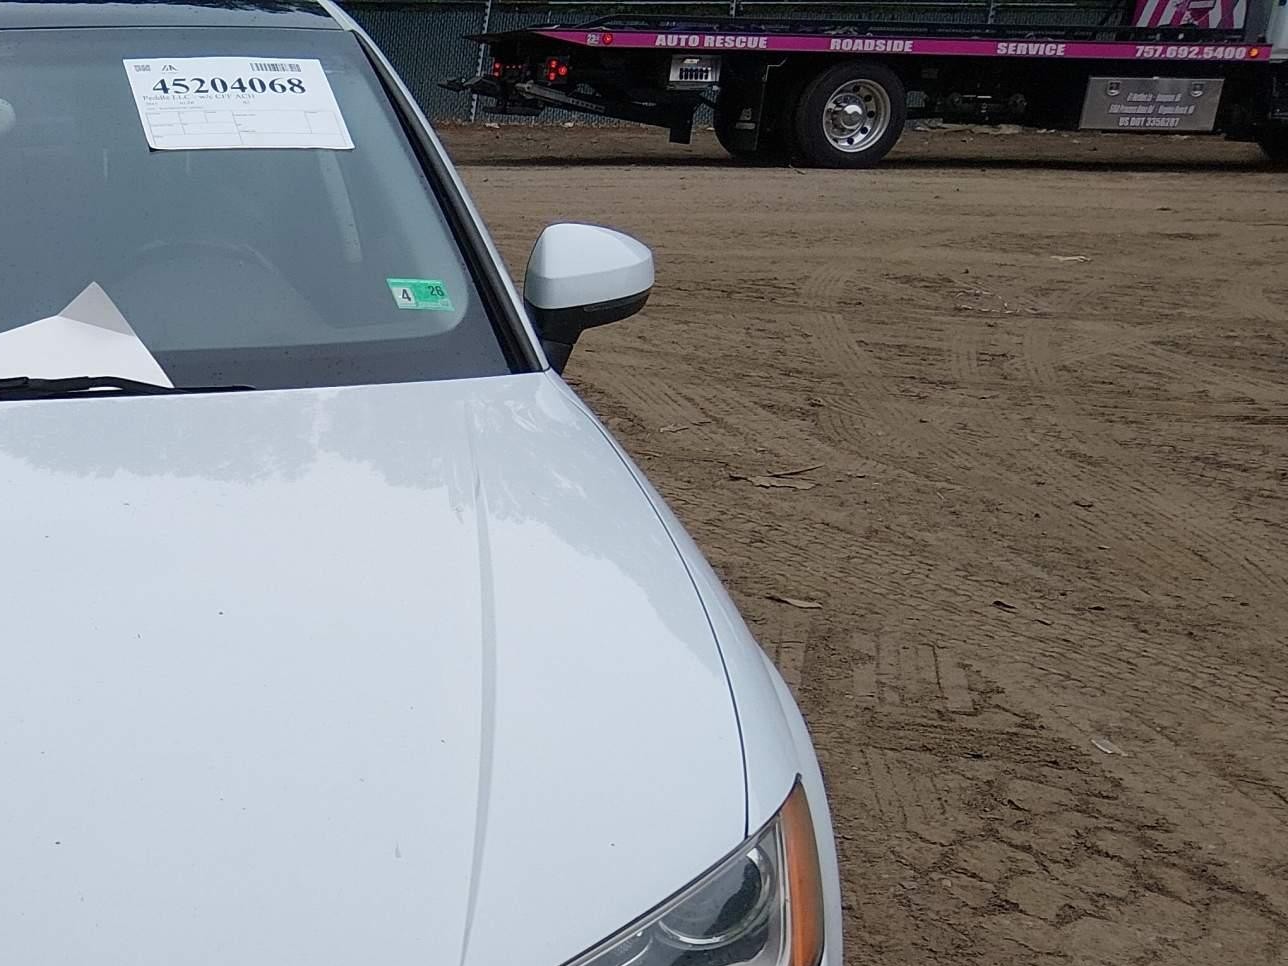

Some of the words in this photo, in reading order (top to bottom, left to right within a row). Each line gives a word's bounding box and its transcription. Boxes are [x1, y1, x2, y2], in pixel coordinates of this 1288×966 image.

[655, 34, 700, 48] AUTO
[703, 35, 768, 49] RESCUE
[830, 38, 914, 52] ROADSIDE
[996, 42, 1066, 56] SERVICE
[1135, 45, 1247, 59] 757.692.5400
[152, 77, 306, 94] 45204068
[401, 288, 411, 302] 4
